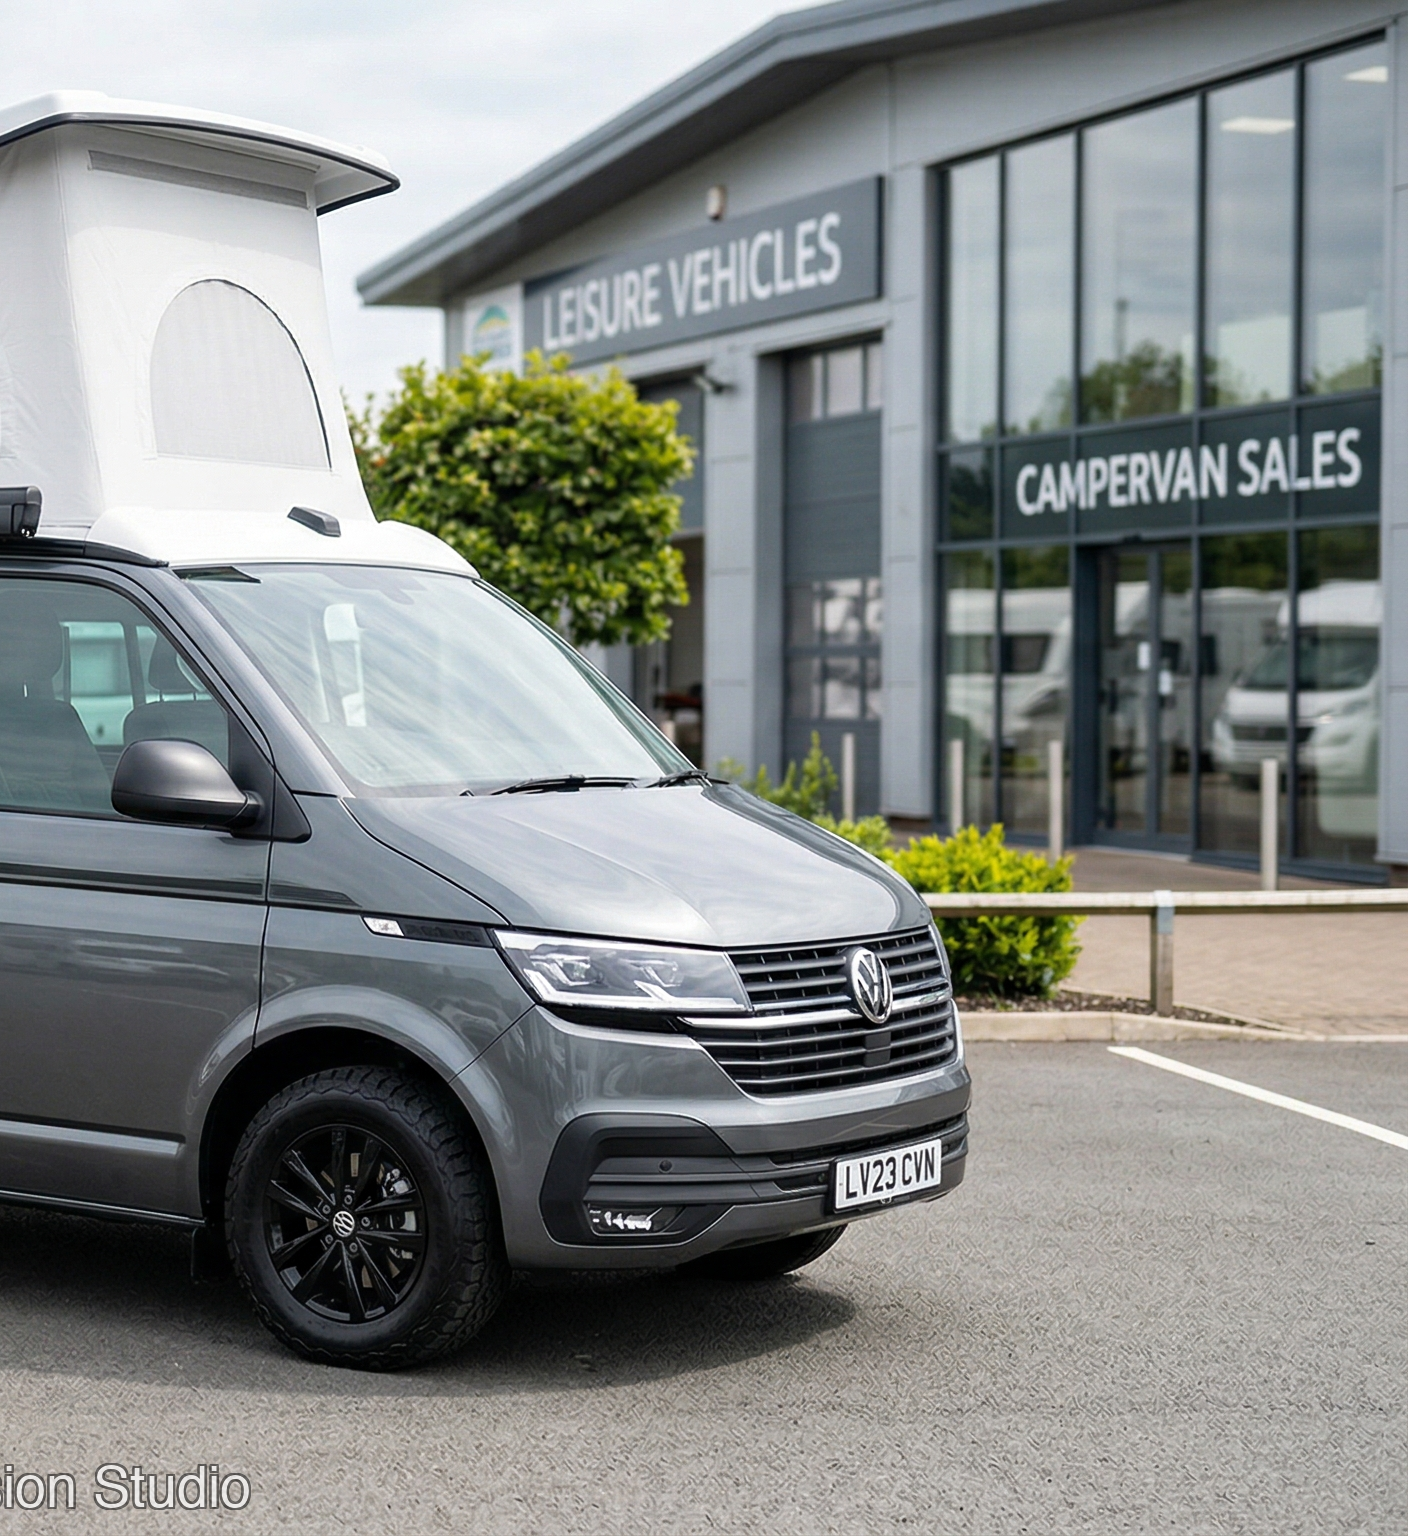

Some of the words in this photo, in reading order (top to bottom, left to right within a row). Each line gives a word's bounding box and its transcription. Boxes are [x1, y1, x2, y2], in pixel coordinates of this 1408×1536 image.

[543, 263, 662, 350] LEISURE
[667, 212, 842, 318] VEHICLES
[1016, 443, 1228, 516] CAMPERVAN
[1237, 427, 1363, 496] SALES
[845, 1156, 897, 1200] LV23
[902, 1146, 935, 1186] CVN
